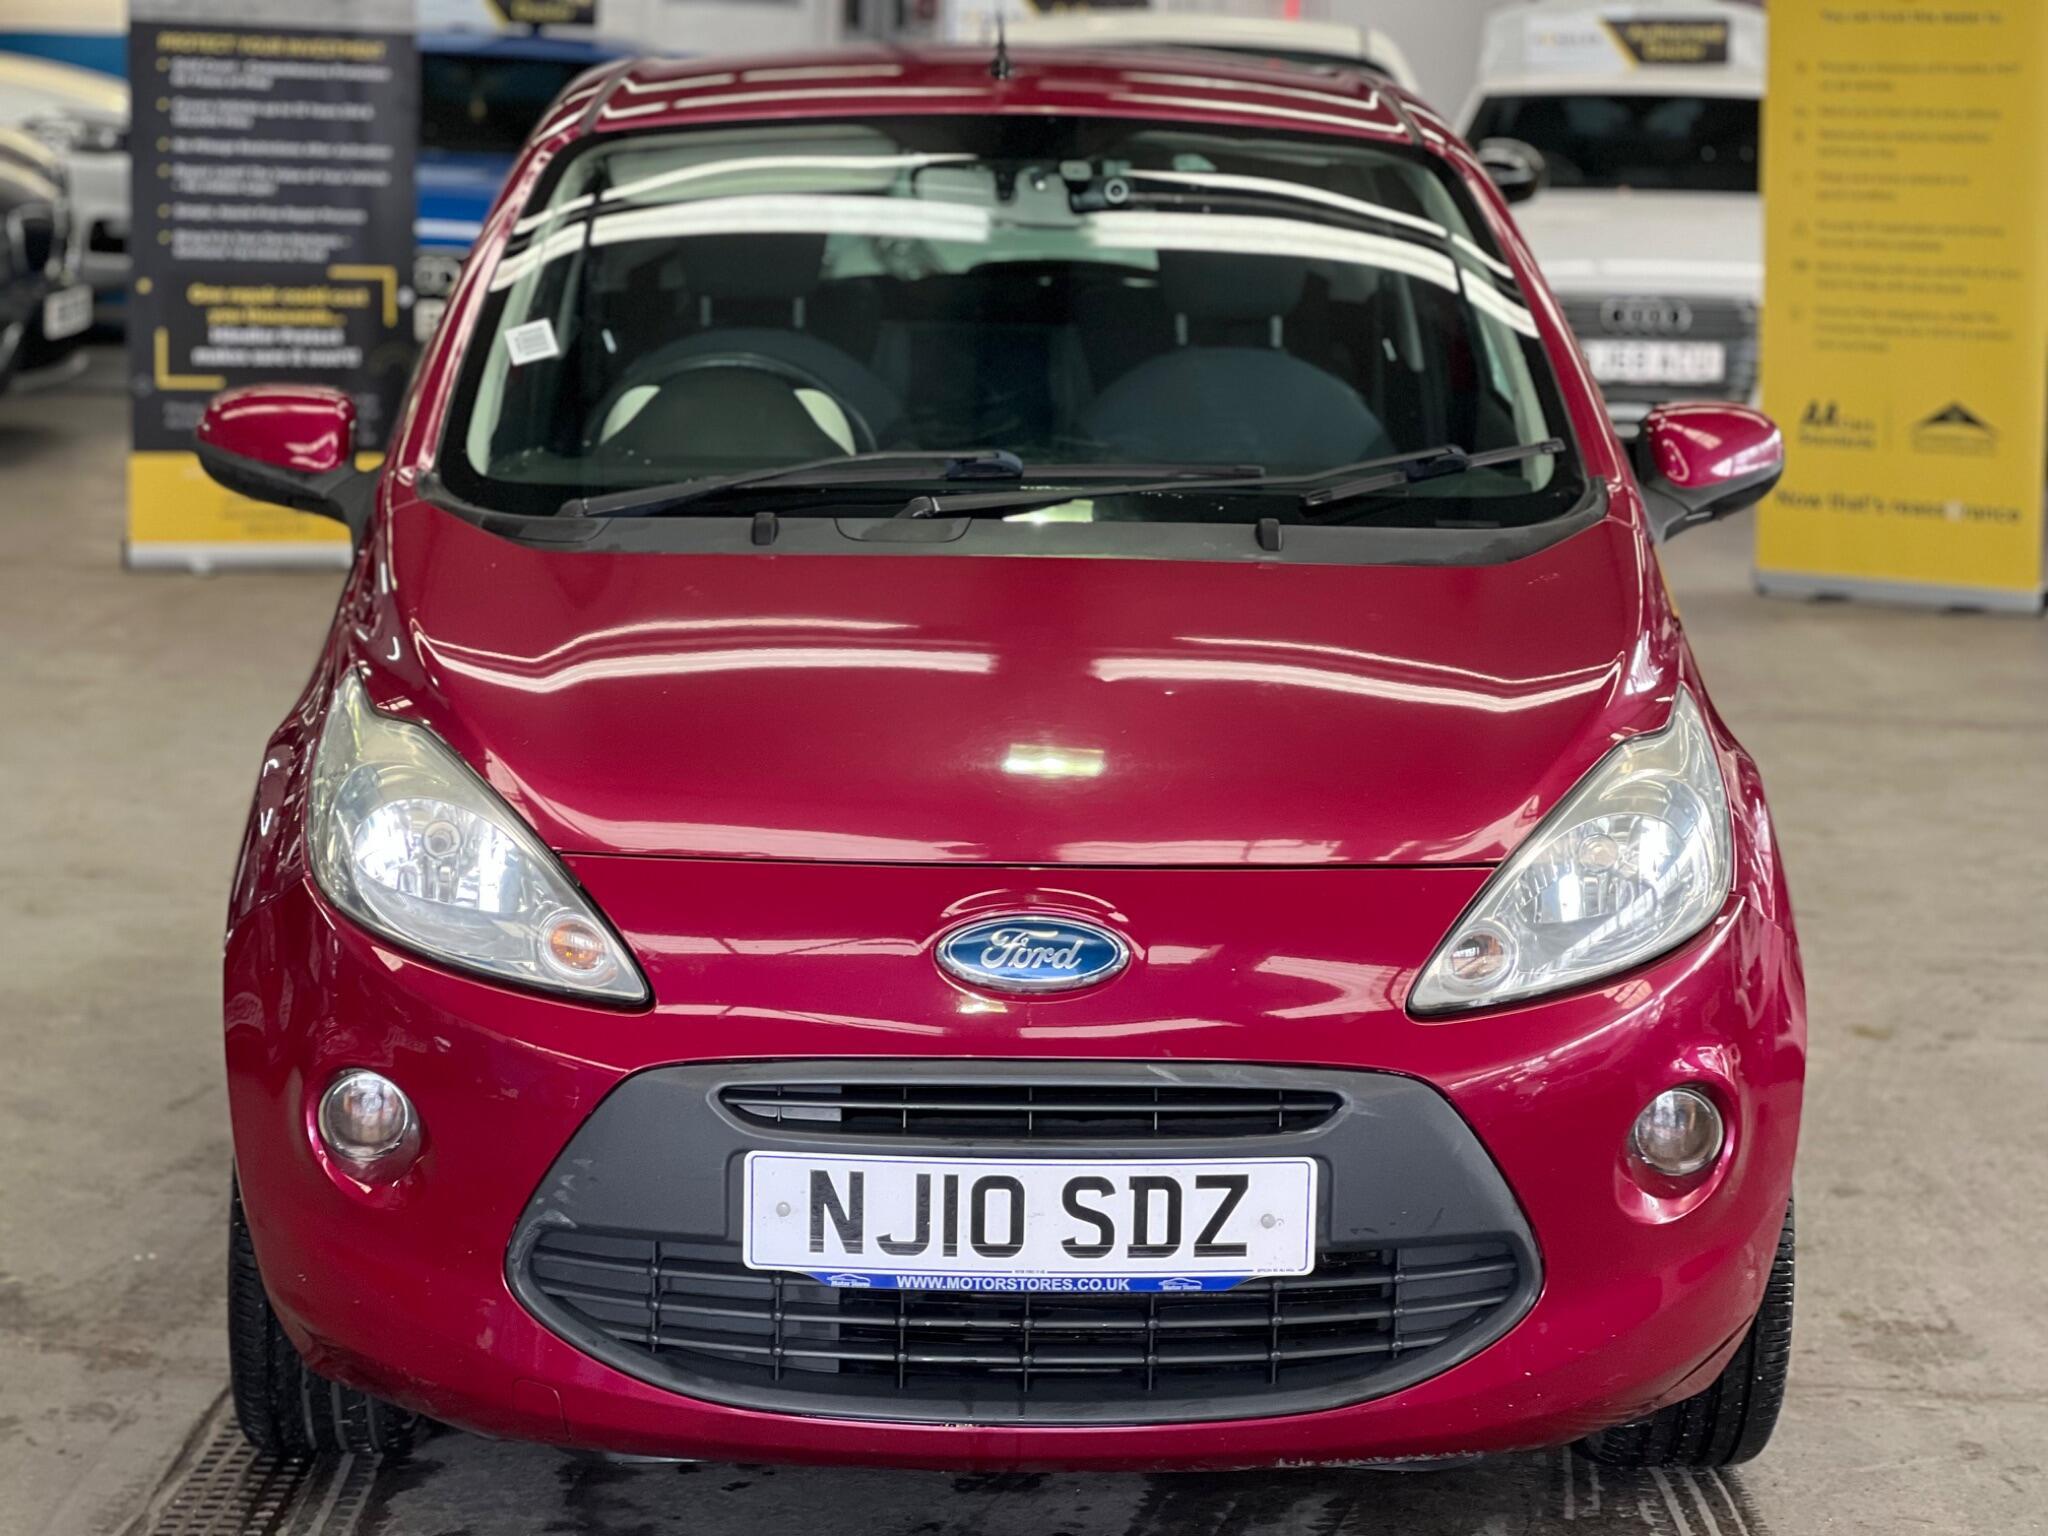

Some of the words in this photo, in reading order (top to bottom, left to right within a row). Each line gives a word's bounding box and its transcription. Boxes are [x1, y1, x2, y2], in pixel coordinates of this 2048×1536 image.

[980, 928, 1085, 969] Ford
[809, 1169, 1025, 1258] NJ10
[1060, 1174, 1249, 1259] SDZ
[896, 1275, 1130, 1292] WWW.MOTORSTORES.CO.UK
